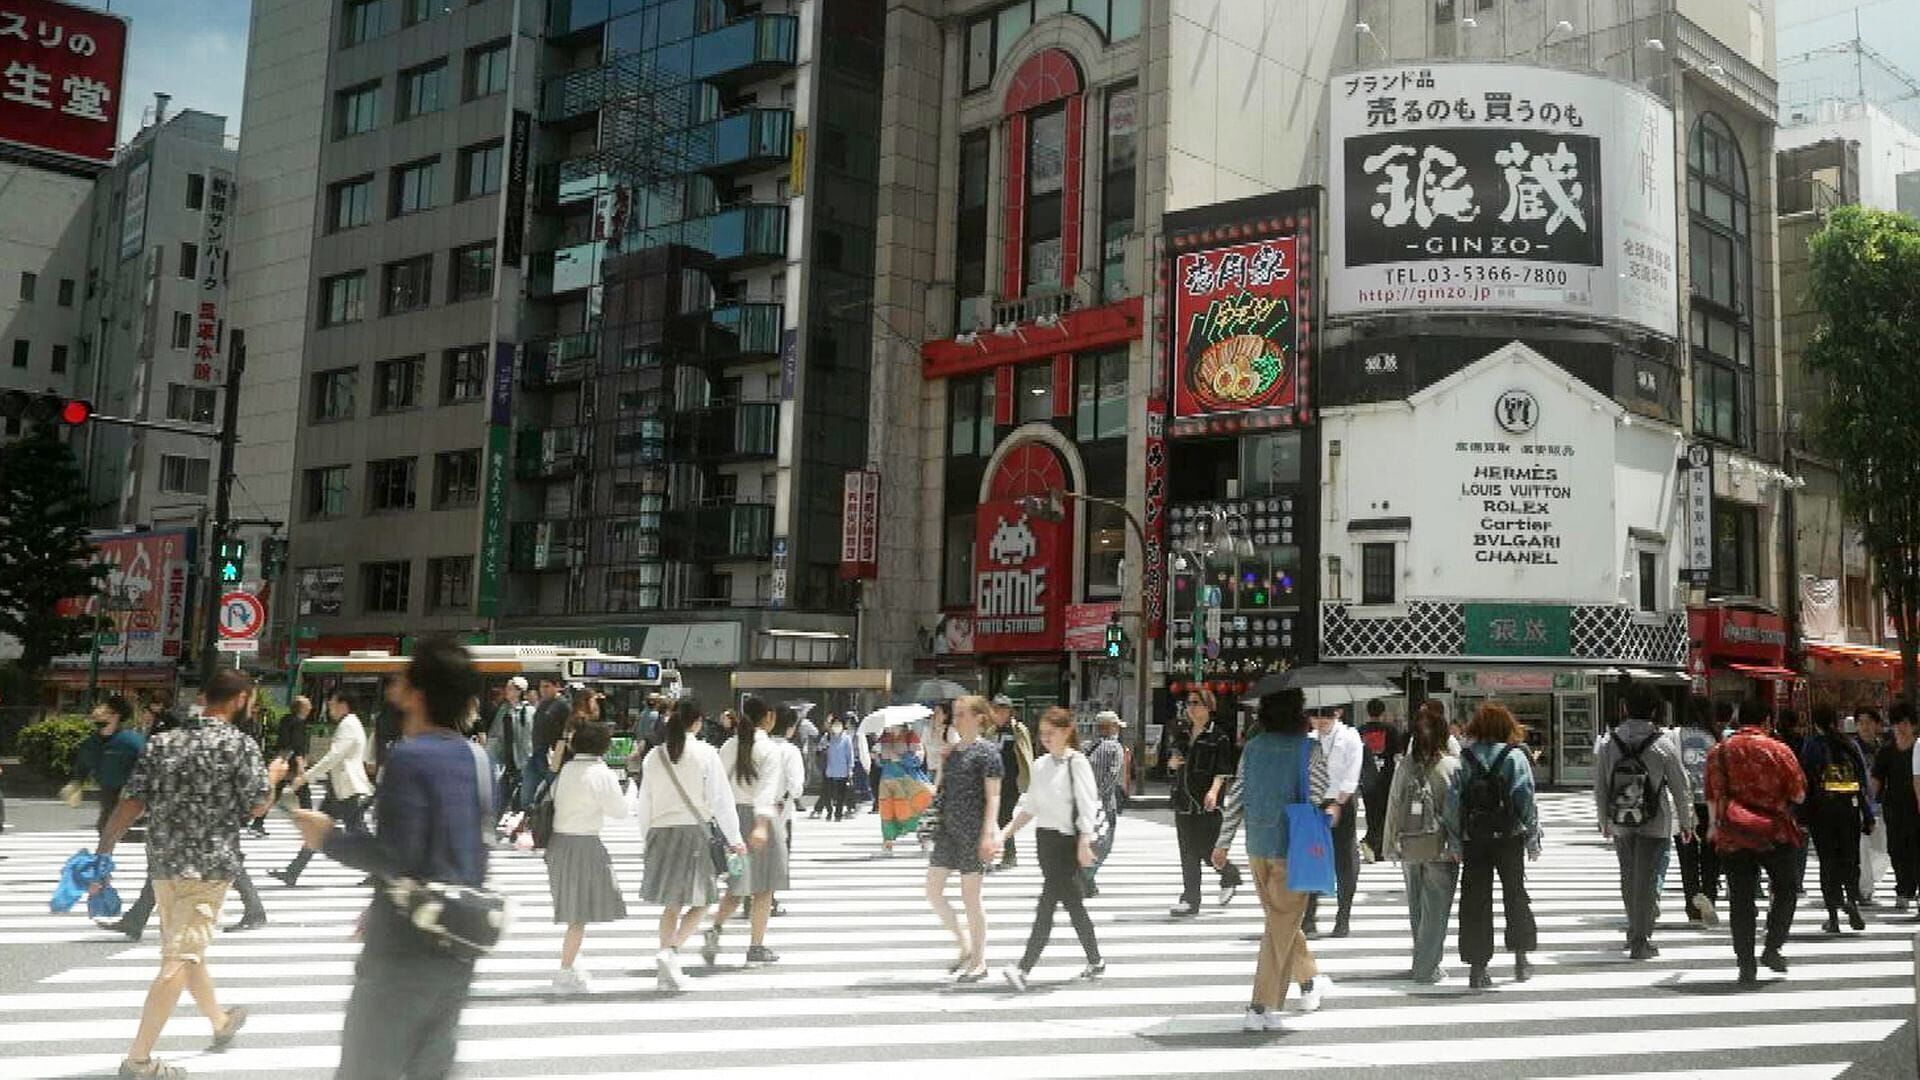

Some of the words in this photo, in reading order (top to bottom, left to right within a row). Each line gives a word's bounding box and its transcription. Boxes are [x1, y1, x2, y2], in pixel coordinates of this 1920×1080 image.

[0, 11, 97, 57] スリの
[3, 60, 111, 122] 生堂
[1345, 68, 1435, 96] ブランド品
[1367, 96, 1476, 128] 売るのも
[1484, 91, 1584, 129] 買うのも
[1386, 265, 1568, 286] TEL.03-5366-7800
[1358, 284, 1491, 304] http://ginzo.jp
[1462, 482, 1502, 497] LOUIS
[1510, 484, 1571, 499] VUITTON
[1483, 500, 1550, 515] ROLEX
[1480, 516, 1552, 532] Cartier
[1473, 532, 1561, 549] BVLGARI
[1475, 550, 1559, 565] CHANEL
[977, 567, 1046, 616] GAME
[607, 637, 632, 653] LAB
